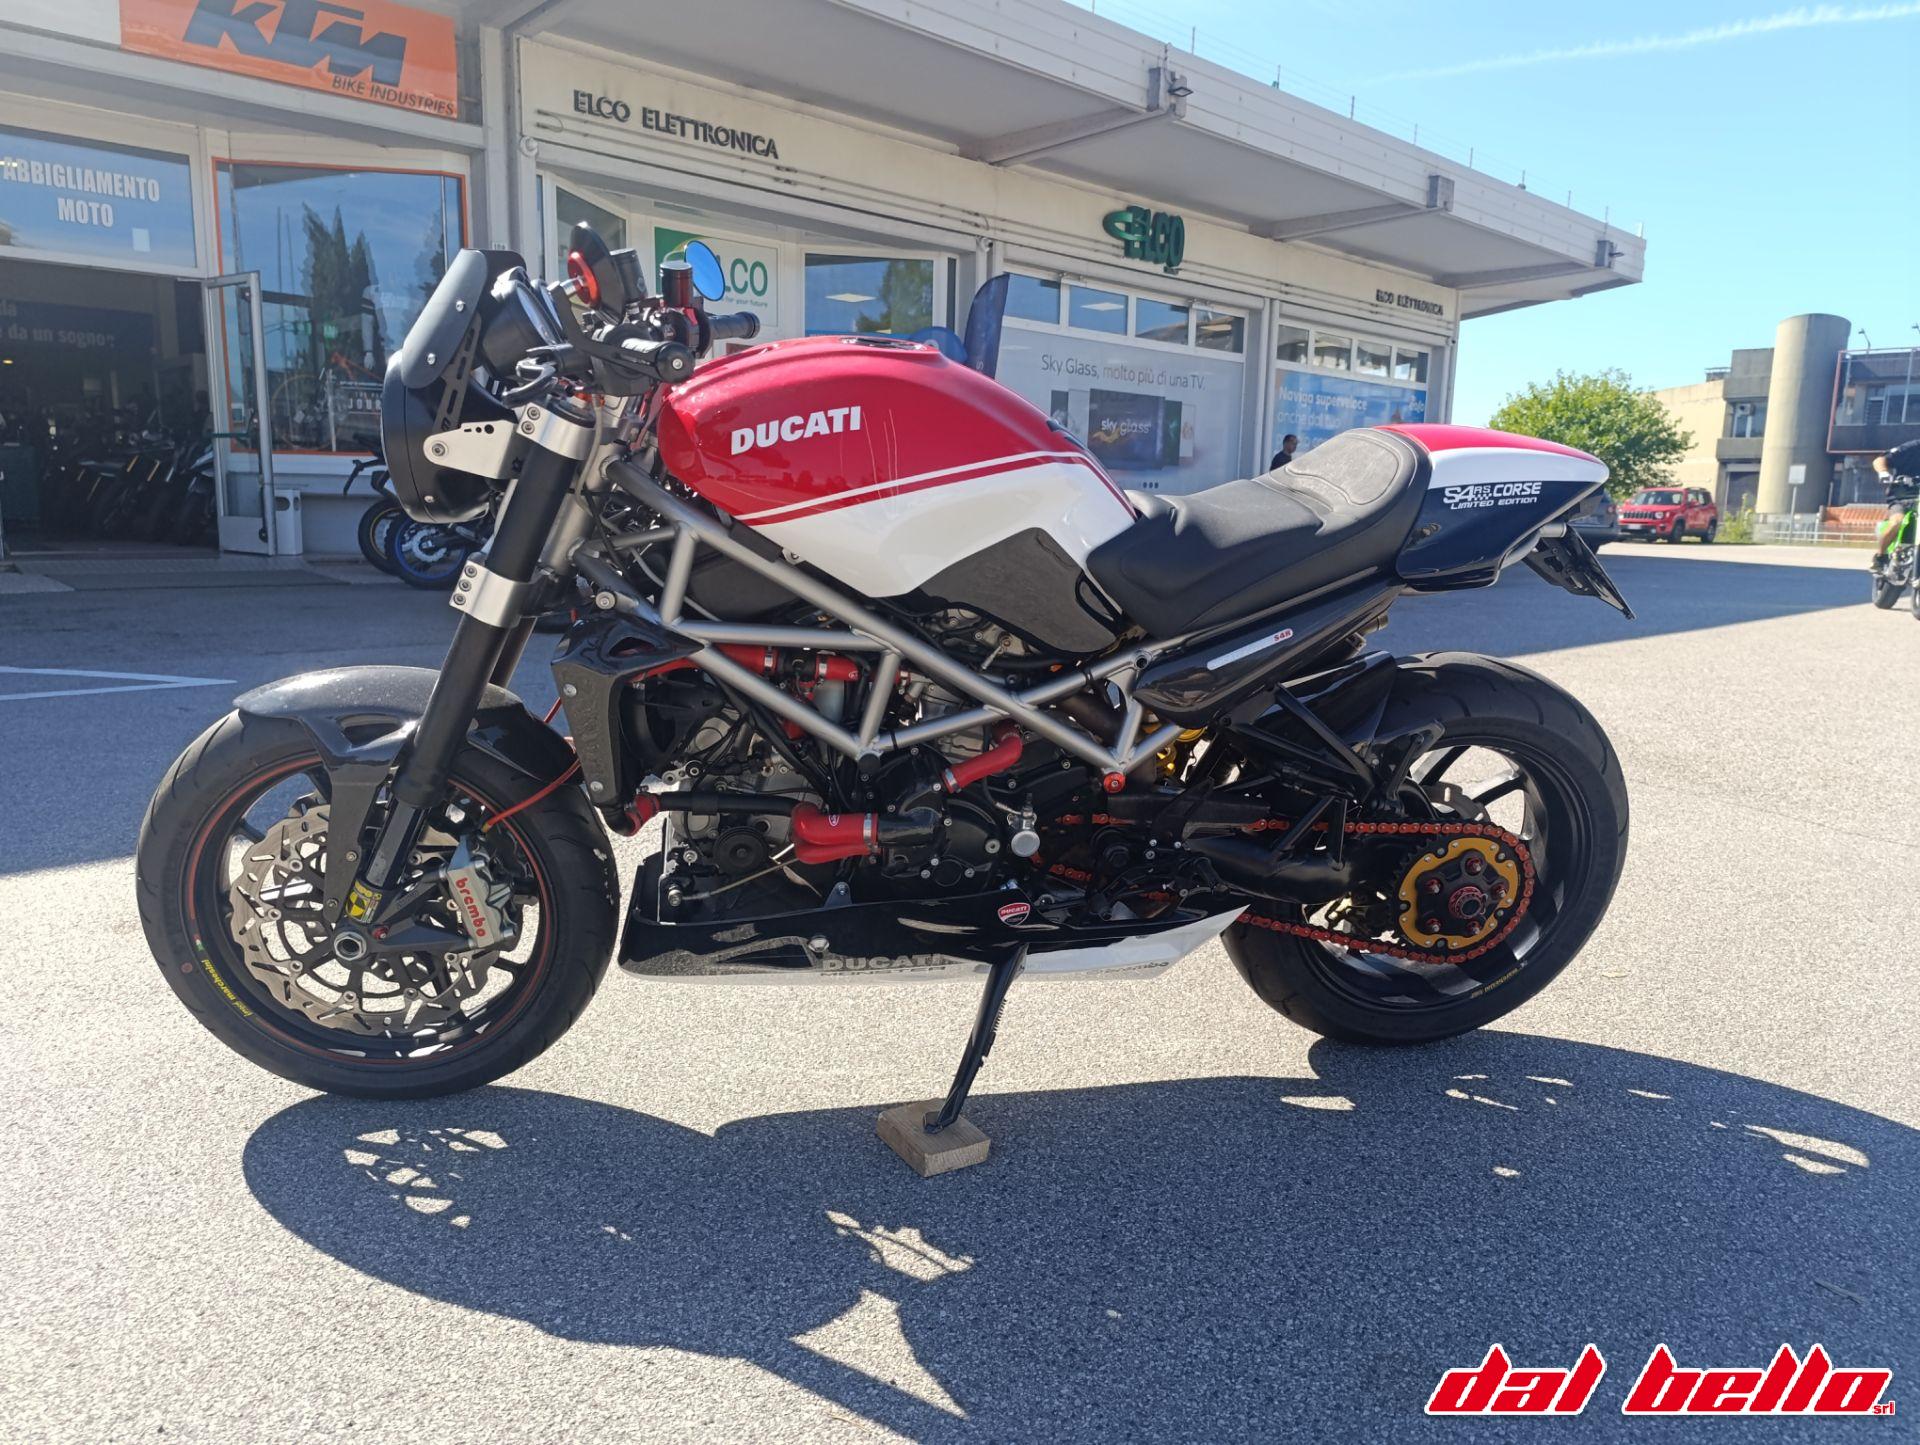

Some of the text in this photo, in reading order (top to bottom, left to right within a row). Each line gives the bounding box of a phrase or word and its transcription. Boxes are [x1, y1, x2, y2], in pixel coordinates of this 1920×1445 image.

[183, 0, 407, 87] KTM
[332, 75, 454, 115] BIKE INDUSTRIES
[573, 90, 779, 159] ELCO ELETTRONICA
[3, 156, 160, 202] ABBIGLIAMENTO
[57, 197, 114, 227] MOTO
[1041, 354, 1063, 374] Sky
[1065, 358, 1100, 380] Glass,
[1103, 364, 1136, 382] molto
[1137, 367, 1154, 386] più
[1157, 370, 1167, 386] di
[1169, 376, 1189, 388] una
[731, 405, 861, 455] DUCATI
[1101, 418, 1150, 436] sky glass
[1450, 496, 1537, 510] LIMITED EDITION
[1493, 482, 1542, 497] CORSE
[455, 877, 486, 937] brembo
